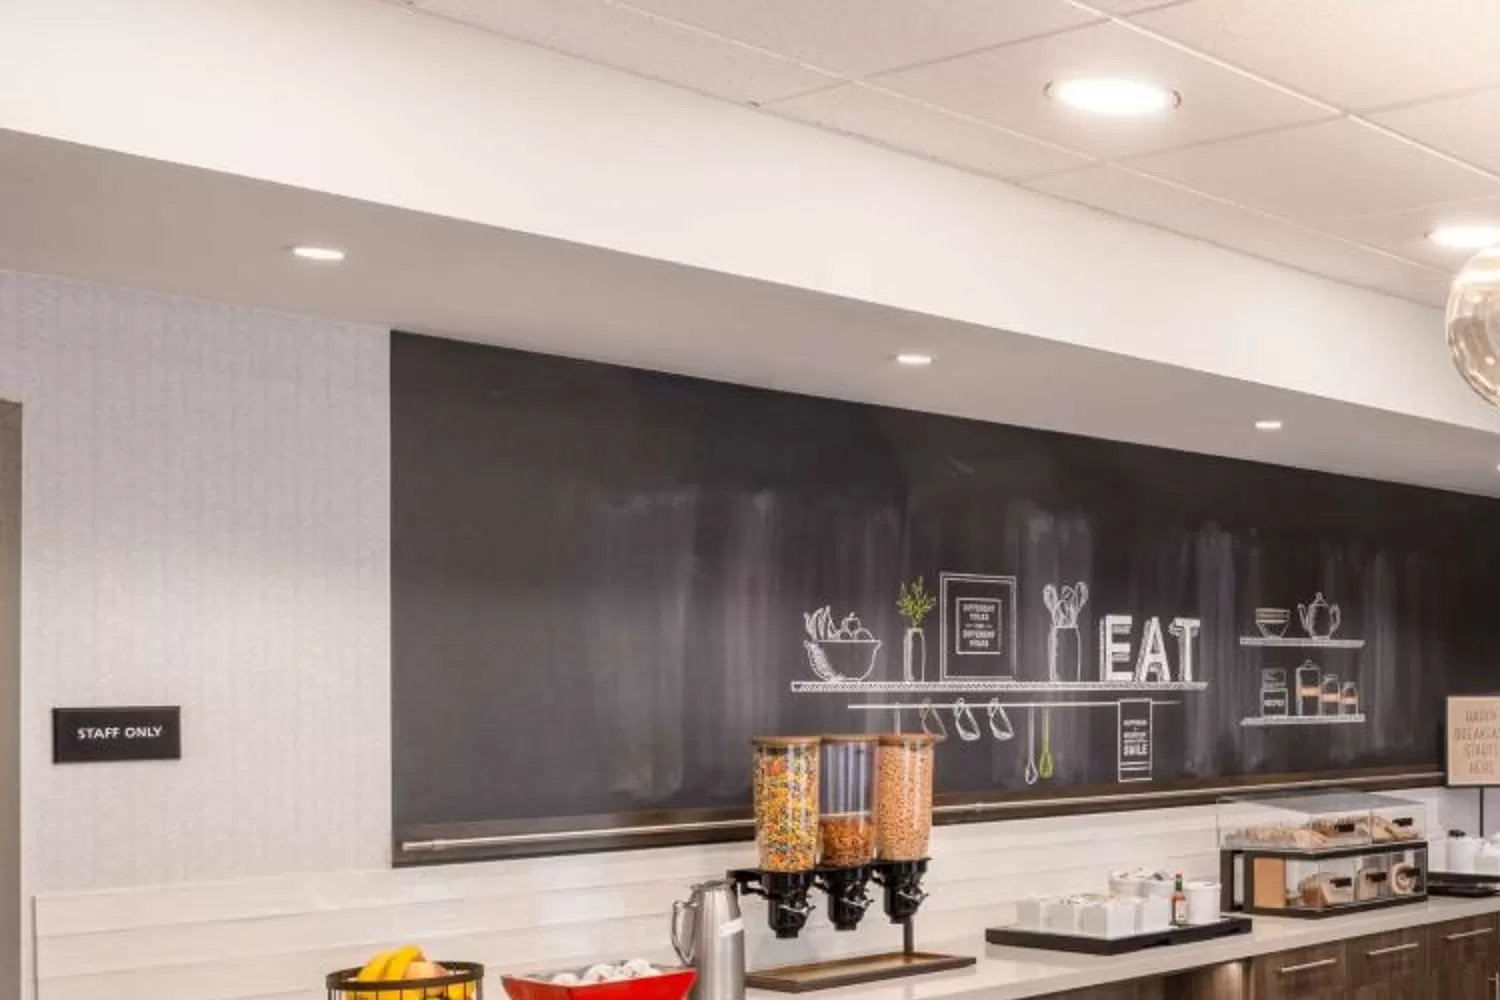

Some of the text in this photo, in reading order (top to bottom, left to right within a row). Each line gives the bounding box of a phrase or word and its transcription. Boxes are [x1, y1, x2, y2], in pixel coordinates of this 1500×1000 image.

[1100, 614, 1201, 682] EAT
[77, 725, 163, 740] STAFF ONLY
